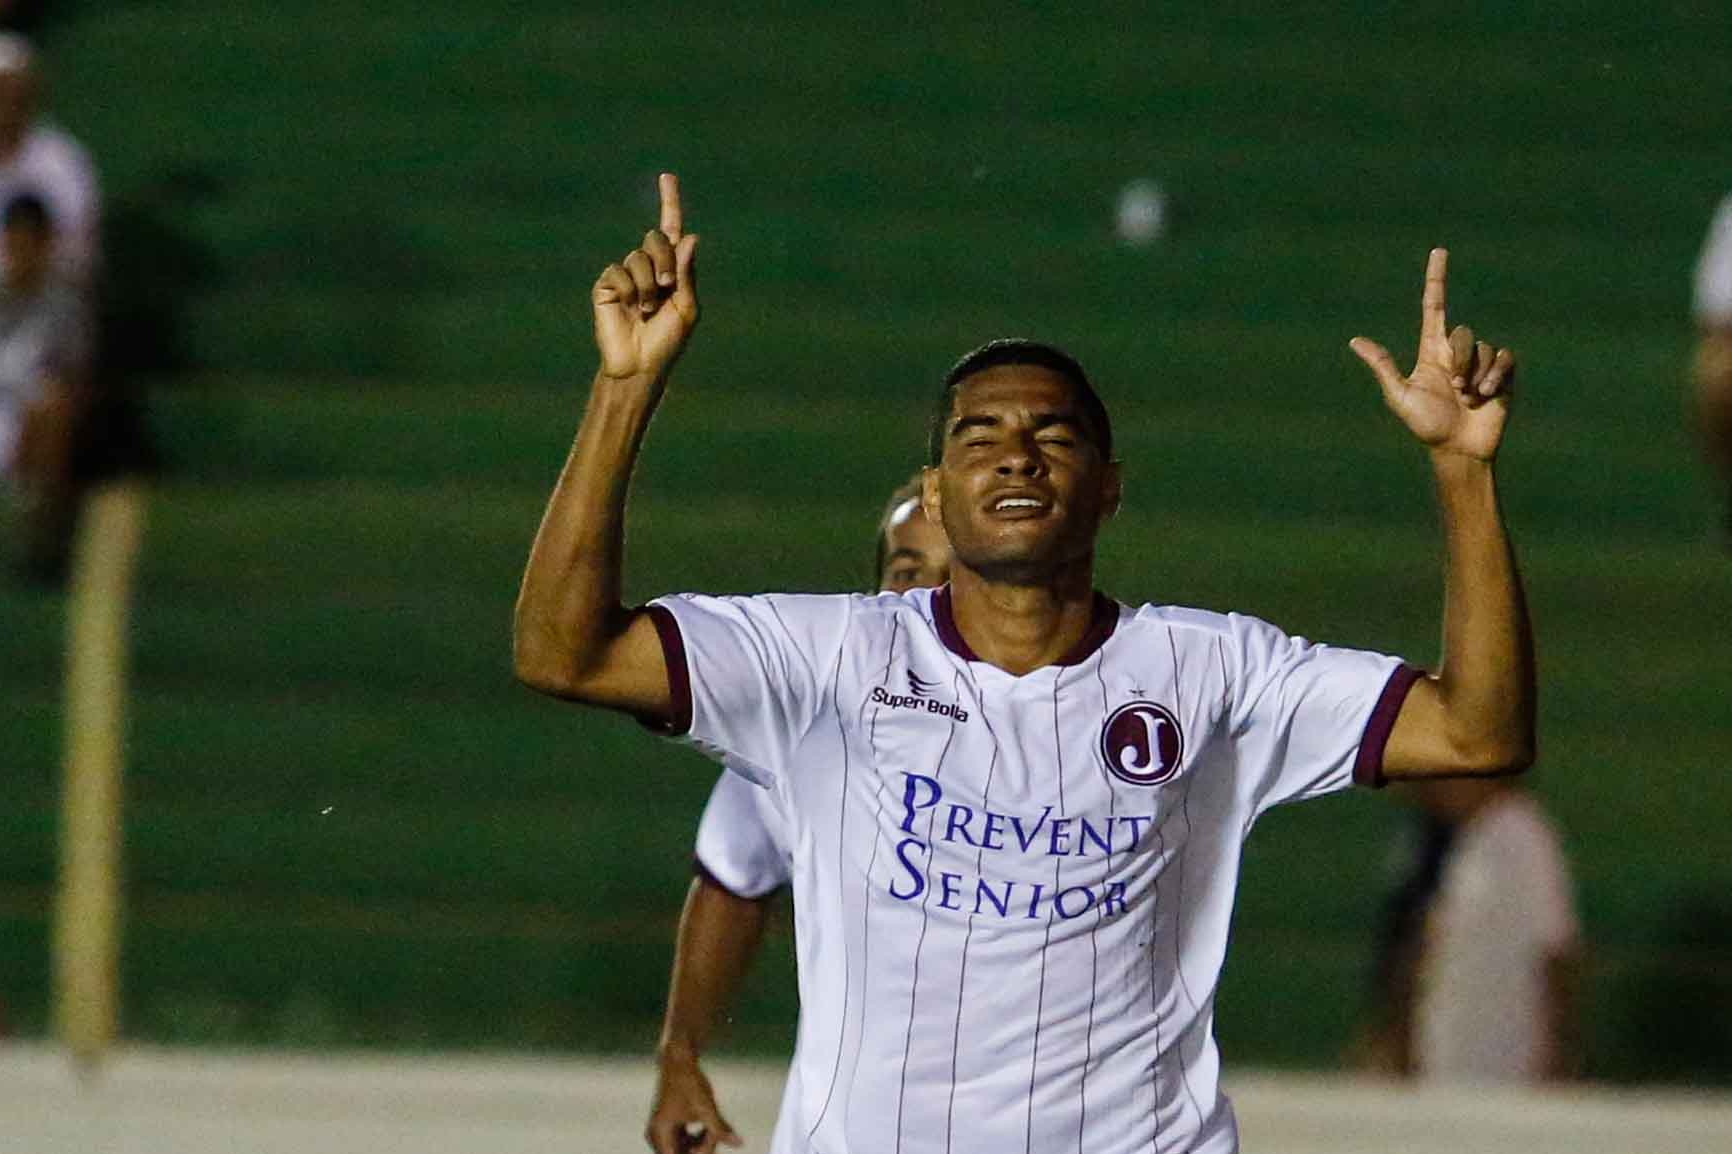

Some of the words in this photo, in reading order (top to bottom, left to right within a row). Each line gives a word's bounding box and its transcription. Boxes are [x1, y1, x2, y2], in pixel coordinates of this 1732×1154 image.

[871, 686, 925, 710] Super
[927, 698, 969, 723] Bolla
[899, 771, 1151, 857] PREVENT
[889, 838, 1130, 919] SENIOR
